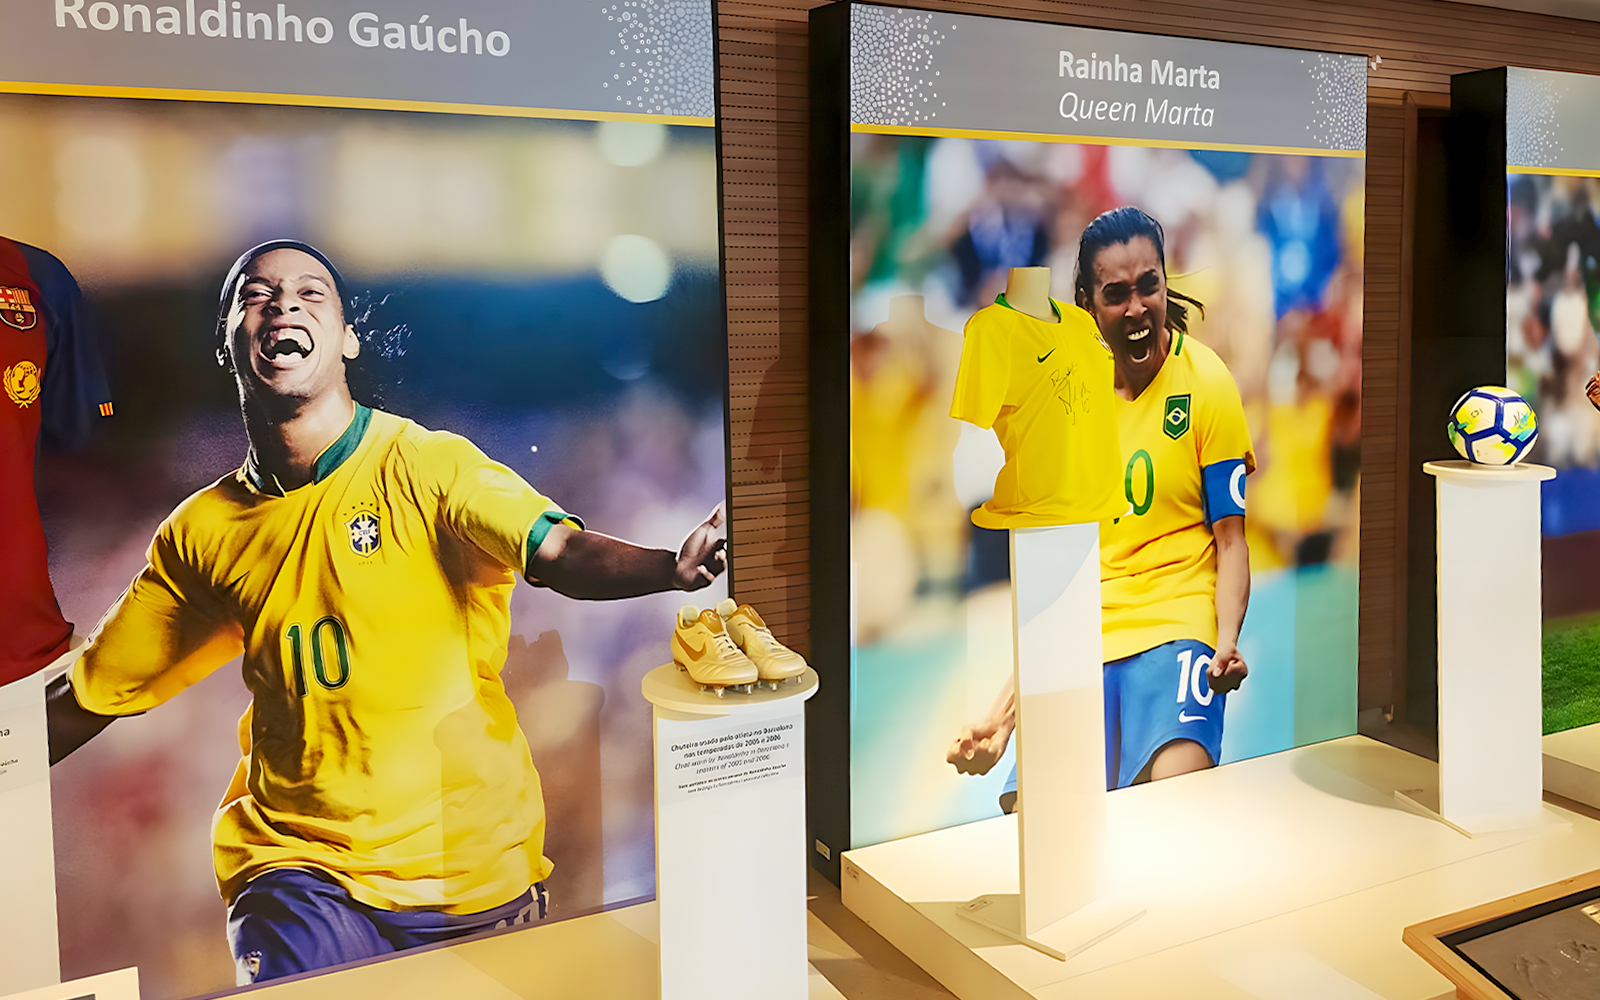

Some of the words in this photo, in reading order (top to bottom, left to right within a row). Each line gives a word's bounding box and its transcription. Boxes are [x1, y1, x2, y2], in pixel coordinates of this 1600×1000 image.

[55, 0, 334, 44] Ronaldinho
[348, 11, 511, 57] Gaúcho
[1058, 50, 1143, 83] Rainha
[1151, 59, 1220, 90] Marta
[1059, 92, 1137, 122] Queen
[1144, 98, 1215, 127] Marta
[1114, 449, 1154, 525] 0
[285, 615, 351, 698] 10
[1176, 650, 1214, 706] 10
